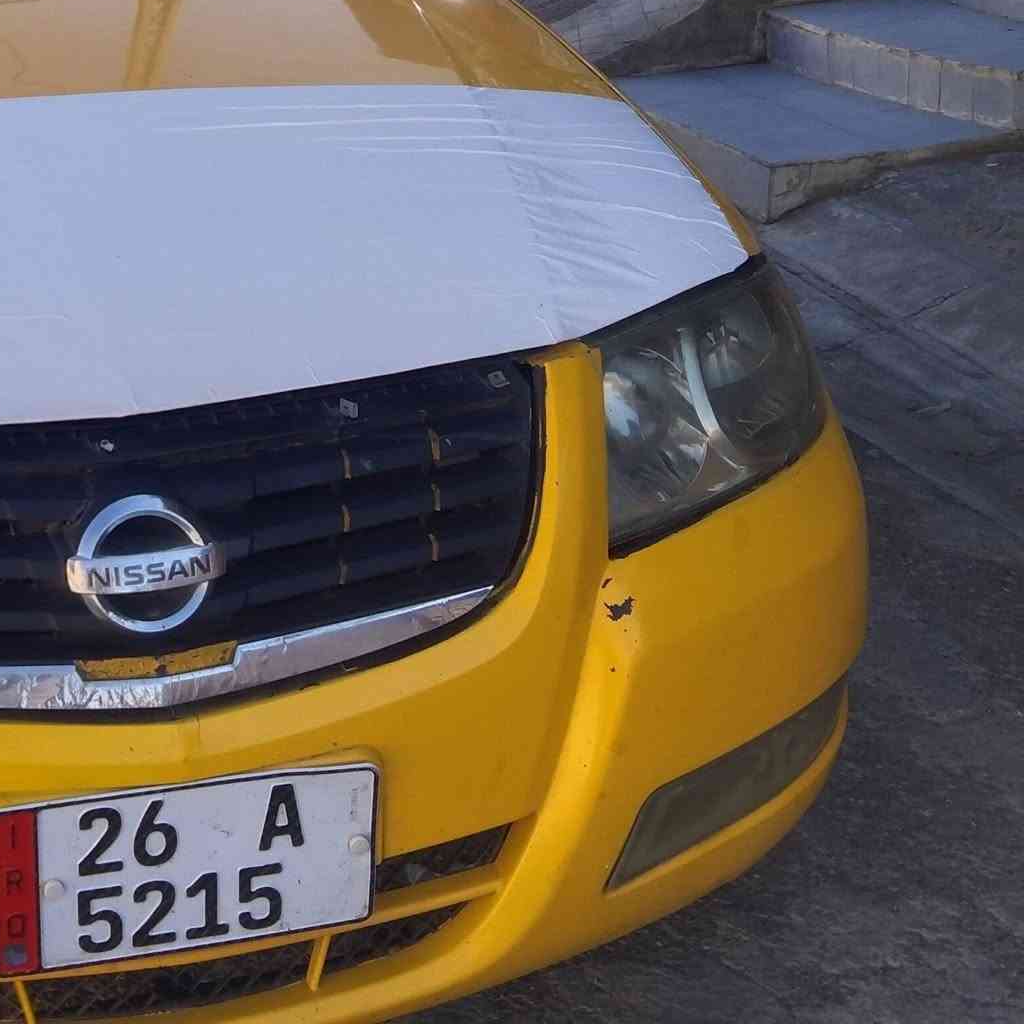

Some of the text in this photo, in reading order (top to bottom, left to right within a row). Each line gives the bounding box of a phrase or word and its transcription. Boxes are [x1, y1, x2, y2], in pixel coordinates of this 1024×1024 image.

[88, 554, 211, 588] NISSAN
[78, 799, 178, 876] 26
[258, 783, 305, 851] A
[77, 862, 283, 954] 5215
